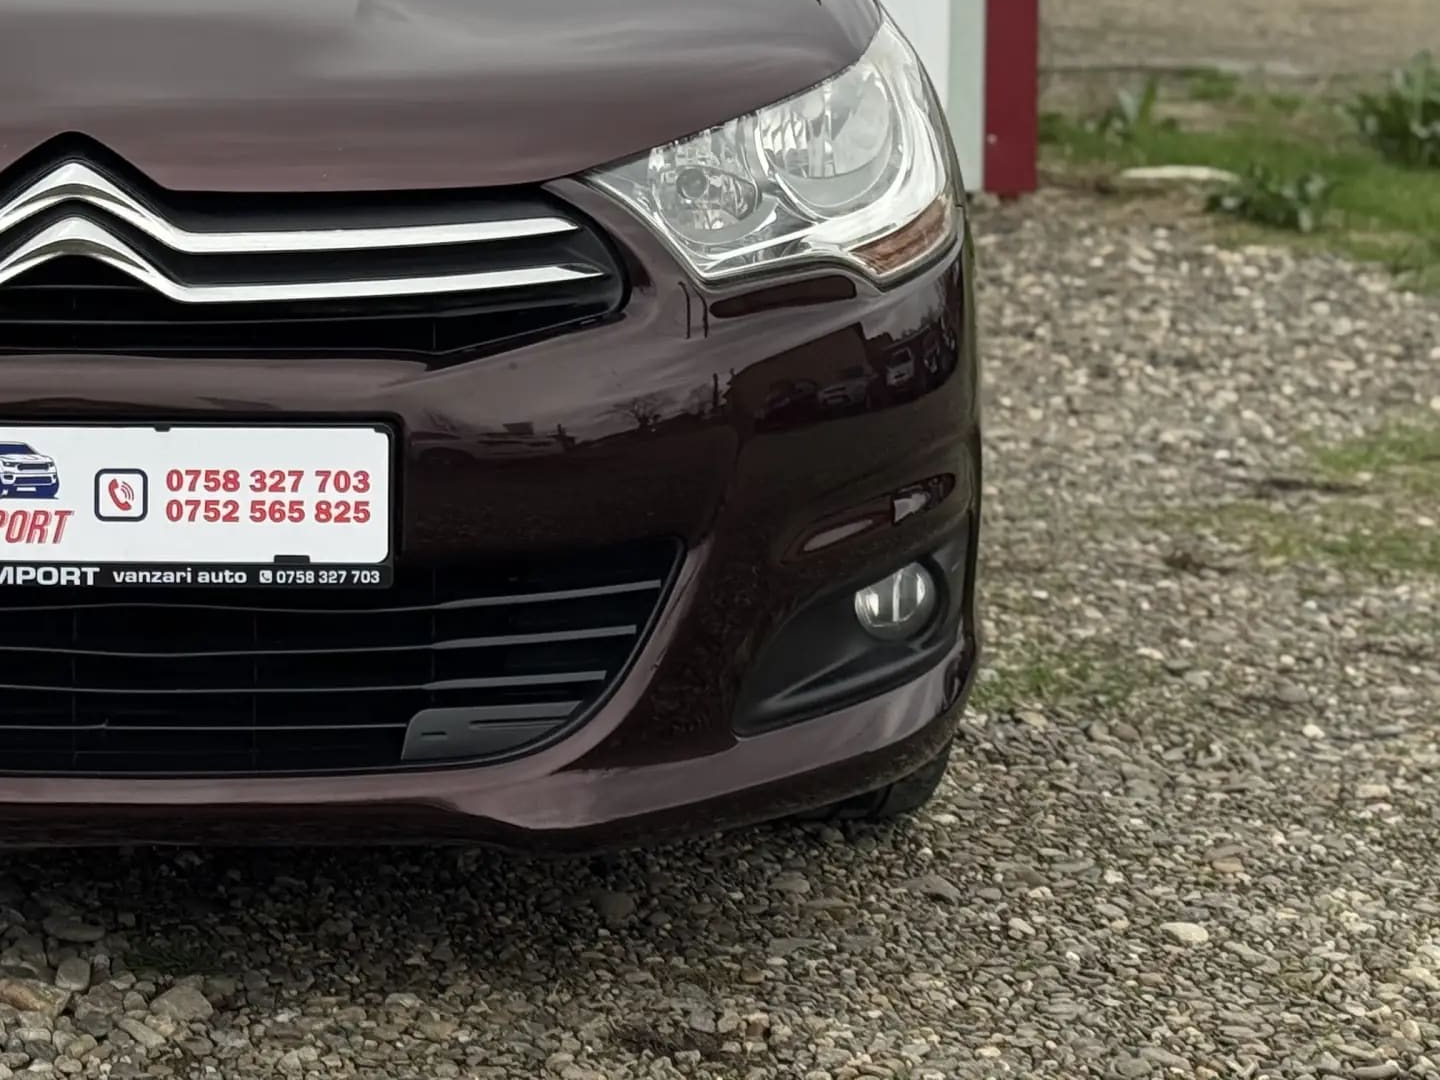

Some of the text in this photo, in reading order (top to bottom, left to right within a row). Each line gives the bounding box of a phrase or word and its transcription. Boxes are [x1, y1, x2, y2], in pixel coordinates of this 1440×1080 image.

[165, 469, 370, 494] 0758 327 703
[165, 499, 370, 524] 0752 565 825
[113, 568, 248, 584] vanzari auto
[275, 570, 381, 584] 0758 327 703
